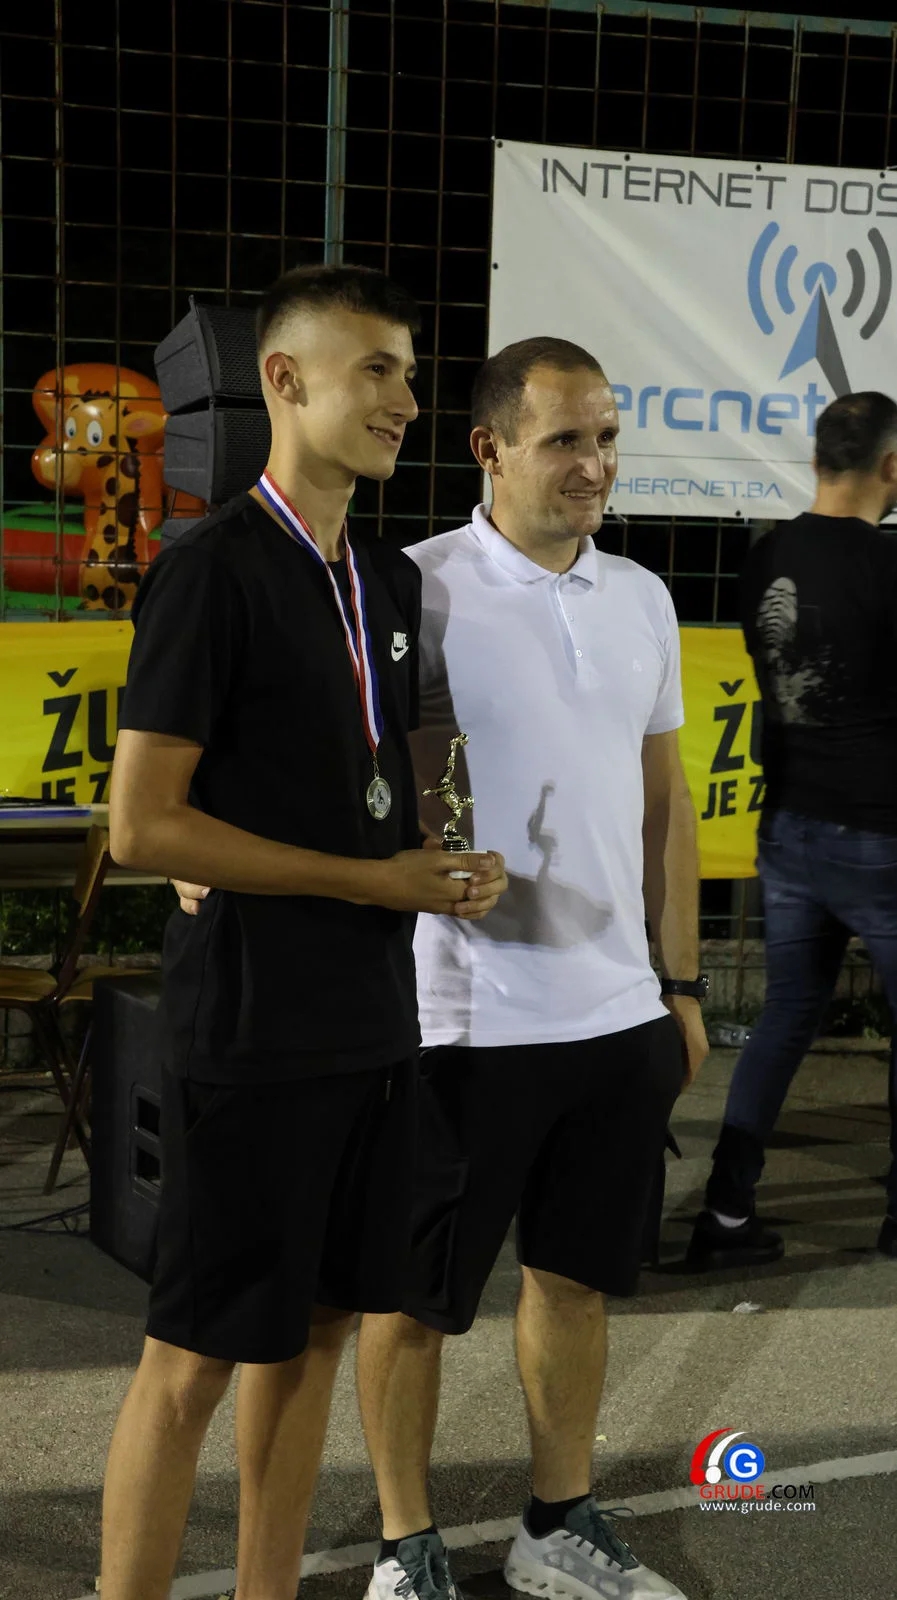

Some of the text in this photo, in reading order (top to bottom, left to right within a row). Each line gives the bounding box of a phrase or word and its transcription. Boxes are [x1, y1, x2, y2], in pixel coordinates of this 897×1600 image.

[542, 158, 786, 209] INTERNET
[393, 631, 407, 649] NIKE
[701, 779, 738, 820] JE
